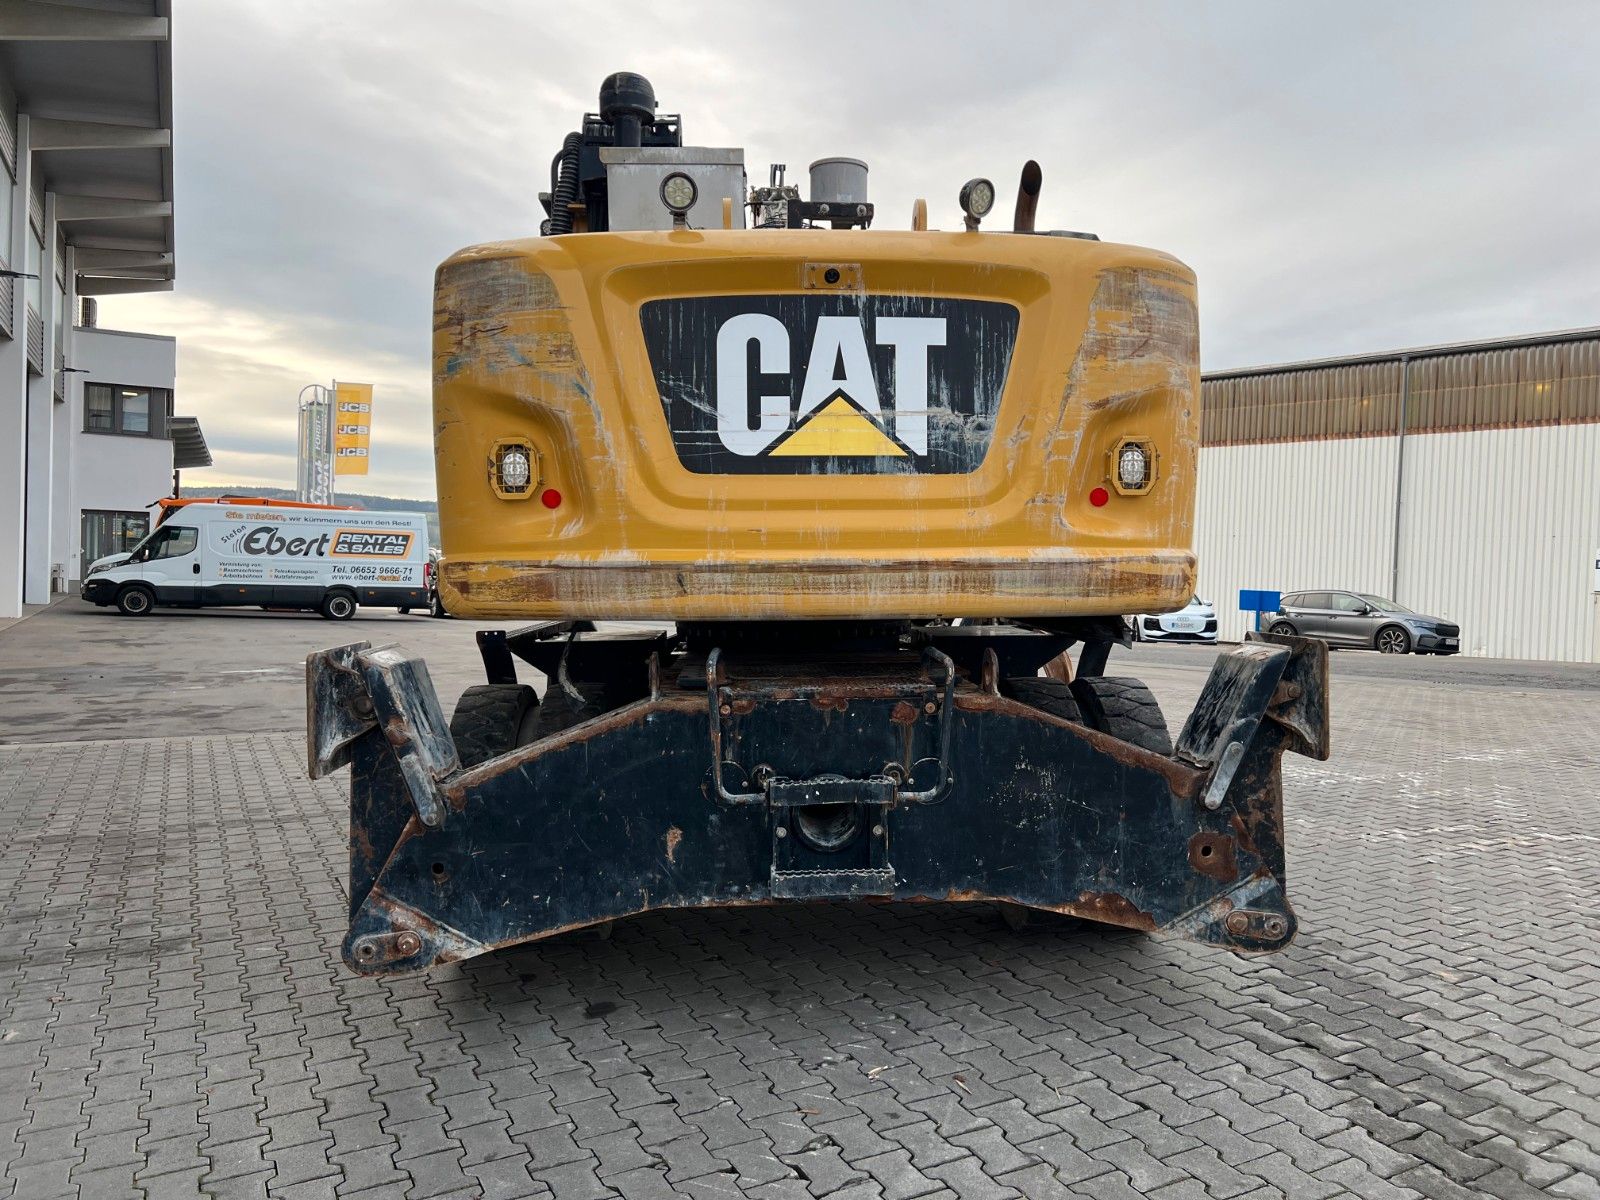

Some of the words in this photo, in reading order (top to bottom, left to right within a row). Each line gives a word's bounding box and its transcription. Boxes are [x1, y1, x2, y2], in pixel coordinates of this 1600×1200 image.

[716, 313, 947, 457] CAT
[339, 402, 370, 413] JCB
[338, 425, 368, 435] JCB
[337, 448, 367, 457] JCB
[225, 511, 244, 519] Sie
[246, 512, 287, 522] mieten,
[304, 516, 342, 524] kümmern
[220, 525, 247, 544] Stefan
[338, 533, 407, 545] RENTAL
[243, 526, 331, 556] Ebert
[335, 544, 349, 553] &
[351, 544, 405, 555] SALES
[332, 565, 347, 573] Tel.
[350, 566, 377, 574] 06652
[379, 567, 413, 575] 9666-71
